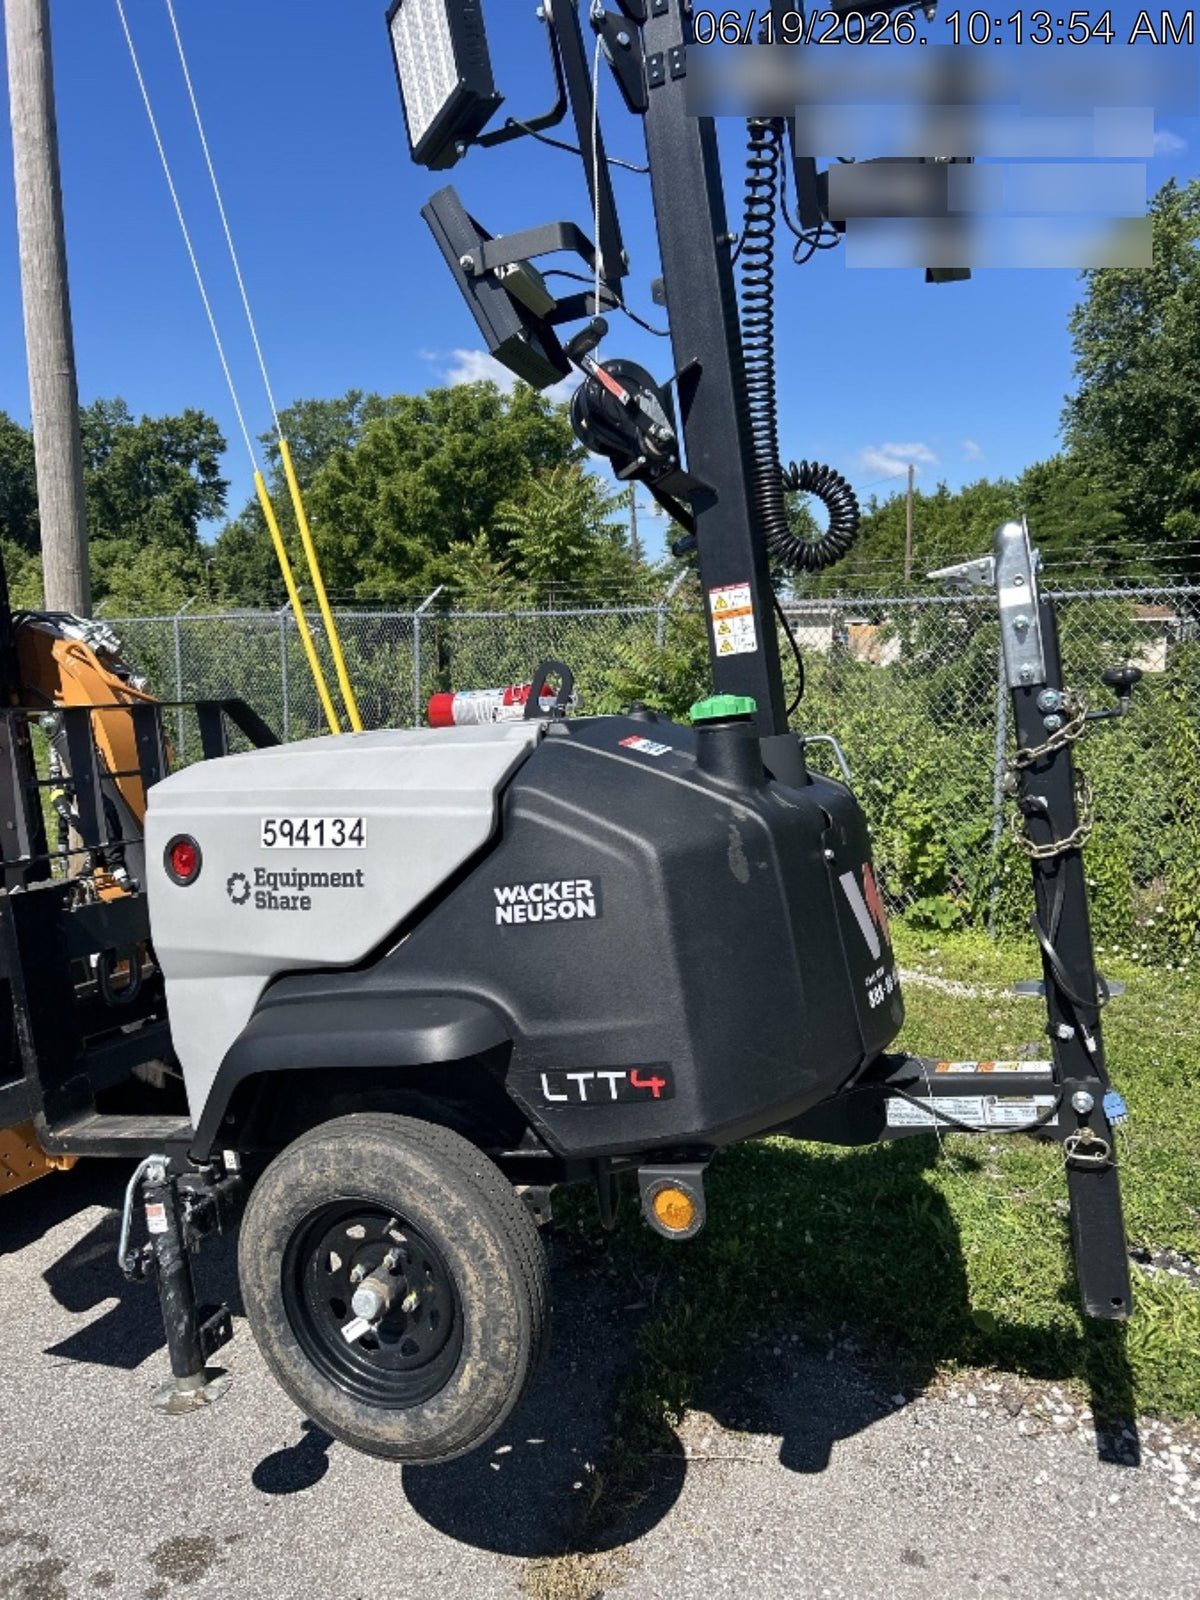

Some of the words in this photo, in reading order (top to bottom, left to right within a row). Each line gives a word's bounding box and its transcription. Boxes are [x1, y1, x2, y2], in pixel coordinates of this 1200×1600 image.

[262, 818, 365, 847] 594134
[253, 867, 365, 891] Equipment
[493, 879, 595, 905] WACKER
[254, 890, 312, 911] Share
[495, 898, 597, 925] NEUSON
[540, 1068, 667, 1101] LTT4
